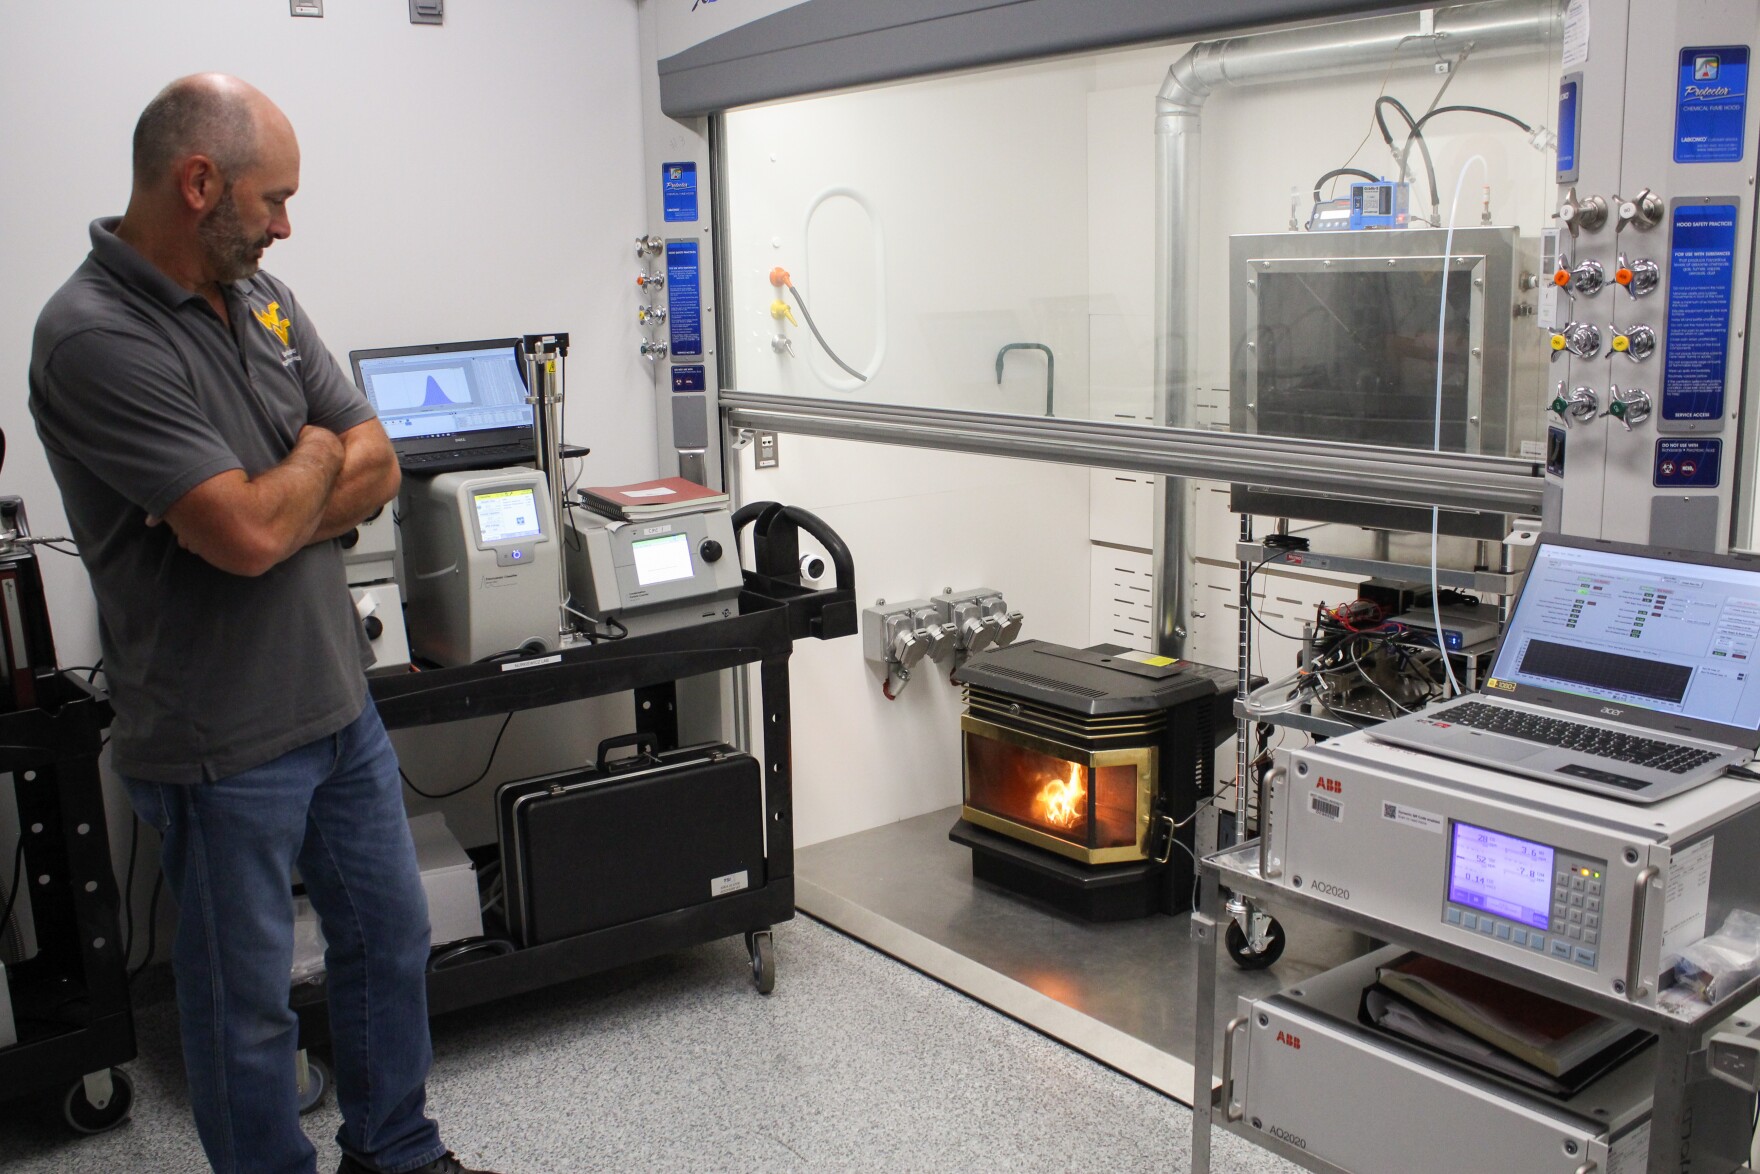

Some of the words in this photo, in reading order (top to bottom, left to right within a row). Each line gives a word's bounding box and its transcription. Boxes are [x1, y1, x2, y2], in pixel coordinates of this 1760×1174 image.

[1685, 85, 1730, 97] Protector
[1600, 706, 1624, 716] acer
[1316, 776, 1342, 794] ABB
[1478, 834, 1488, 843] 28
[1521, 846, 1537, 857] 3.6
[1476, 855, 1487, 864] 52
[1465, 873, 1485, 885] 0.14
[1311, 880, 1350, 900] AO2020
[1277, 1030, 1301, 1050] ABB
[1269, 1125, 1307, 1149] AO2020
